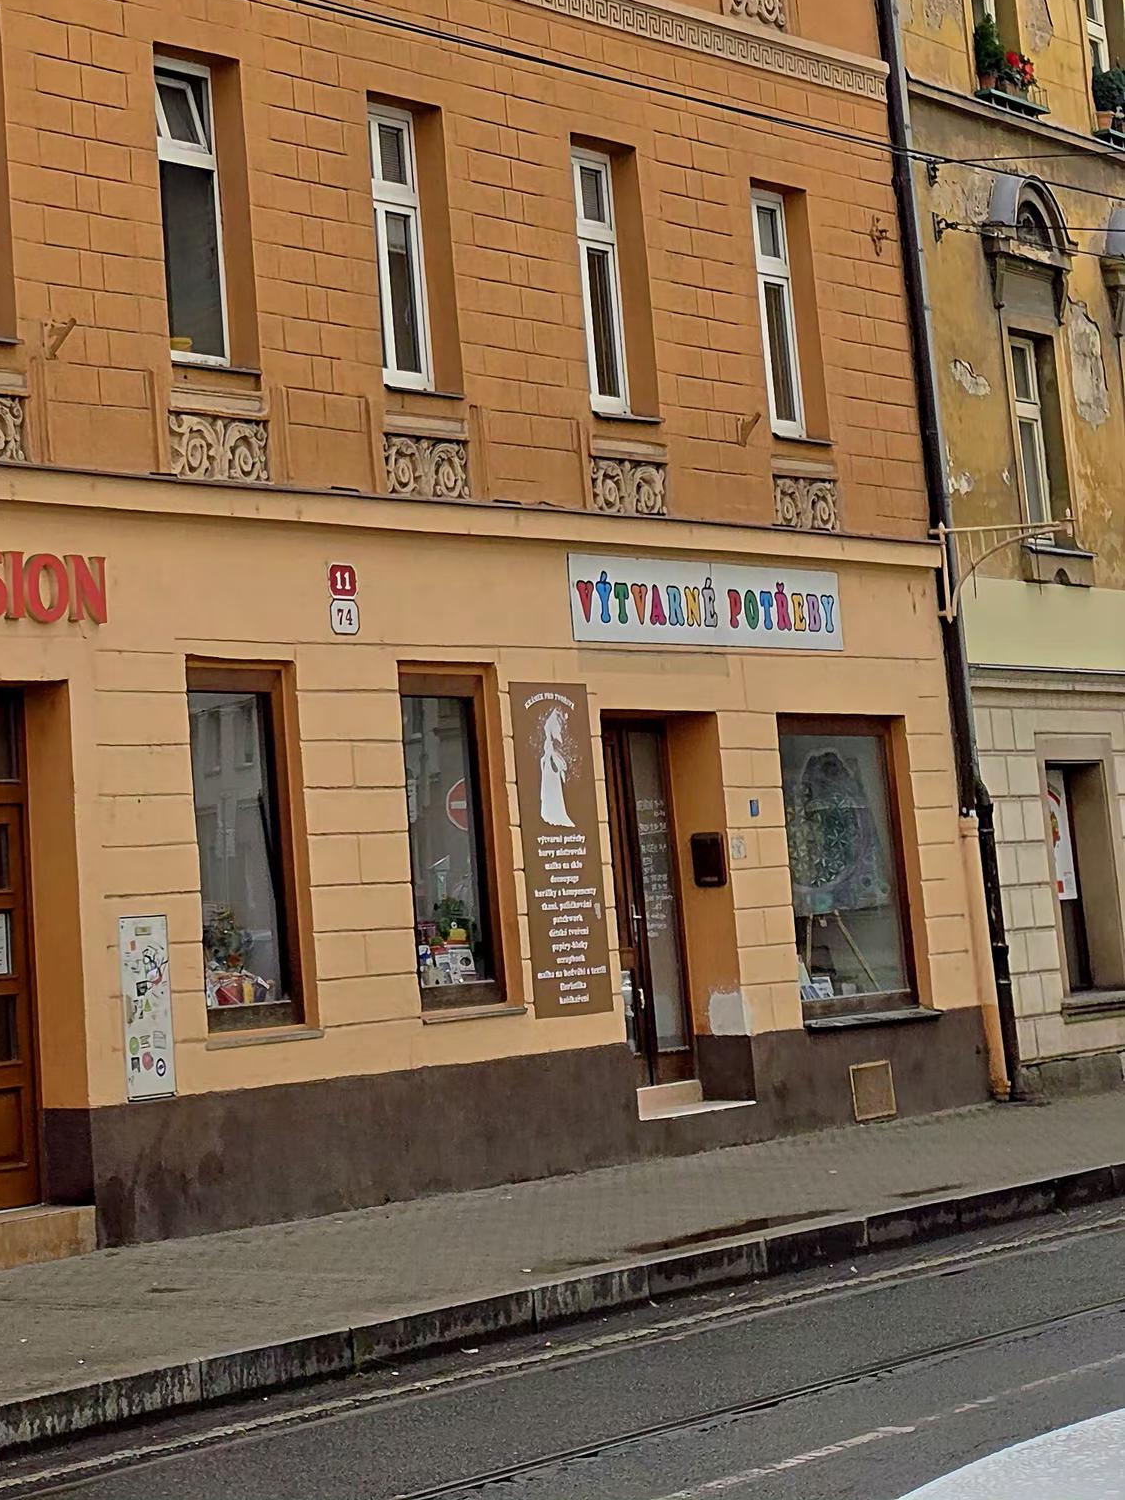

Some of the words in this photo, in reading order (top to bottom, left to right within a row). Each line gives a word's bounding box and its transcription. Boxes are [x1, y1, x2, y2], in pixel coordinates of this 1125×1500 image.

[335, 571, 351, 590] 11
[576, 570, 718, 628] VÝTVARNÉ
[727, 581, 835, 633] POTŘEBY
[337, 608, 353, 626] 74
